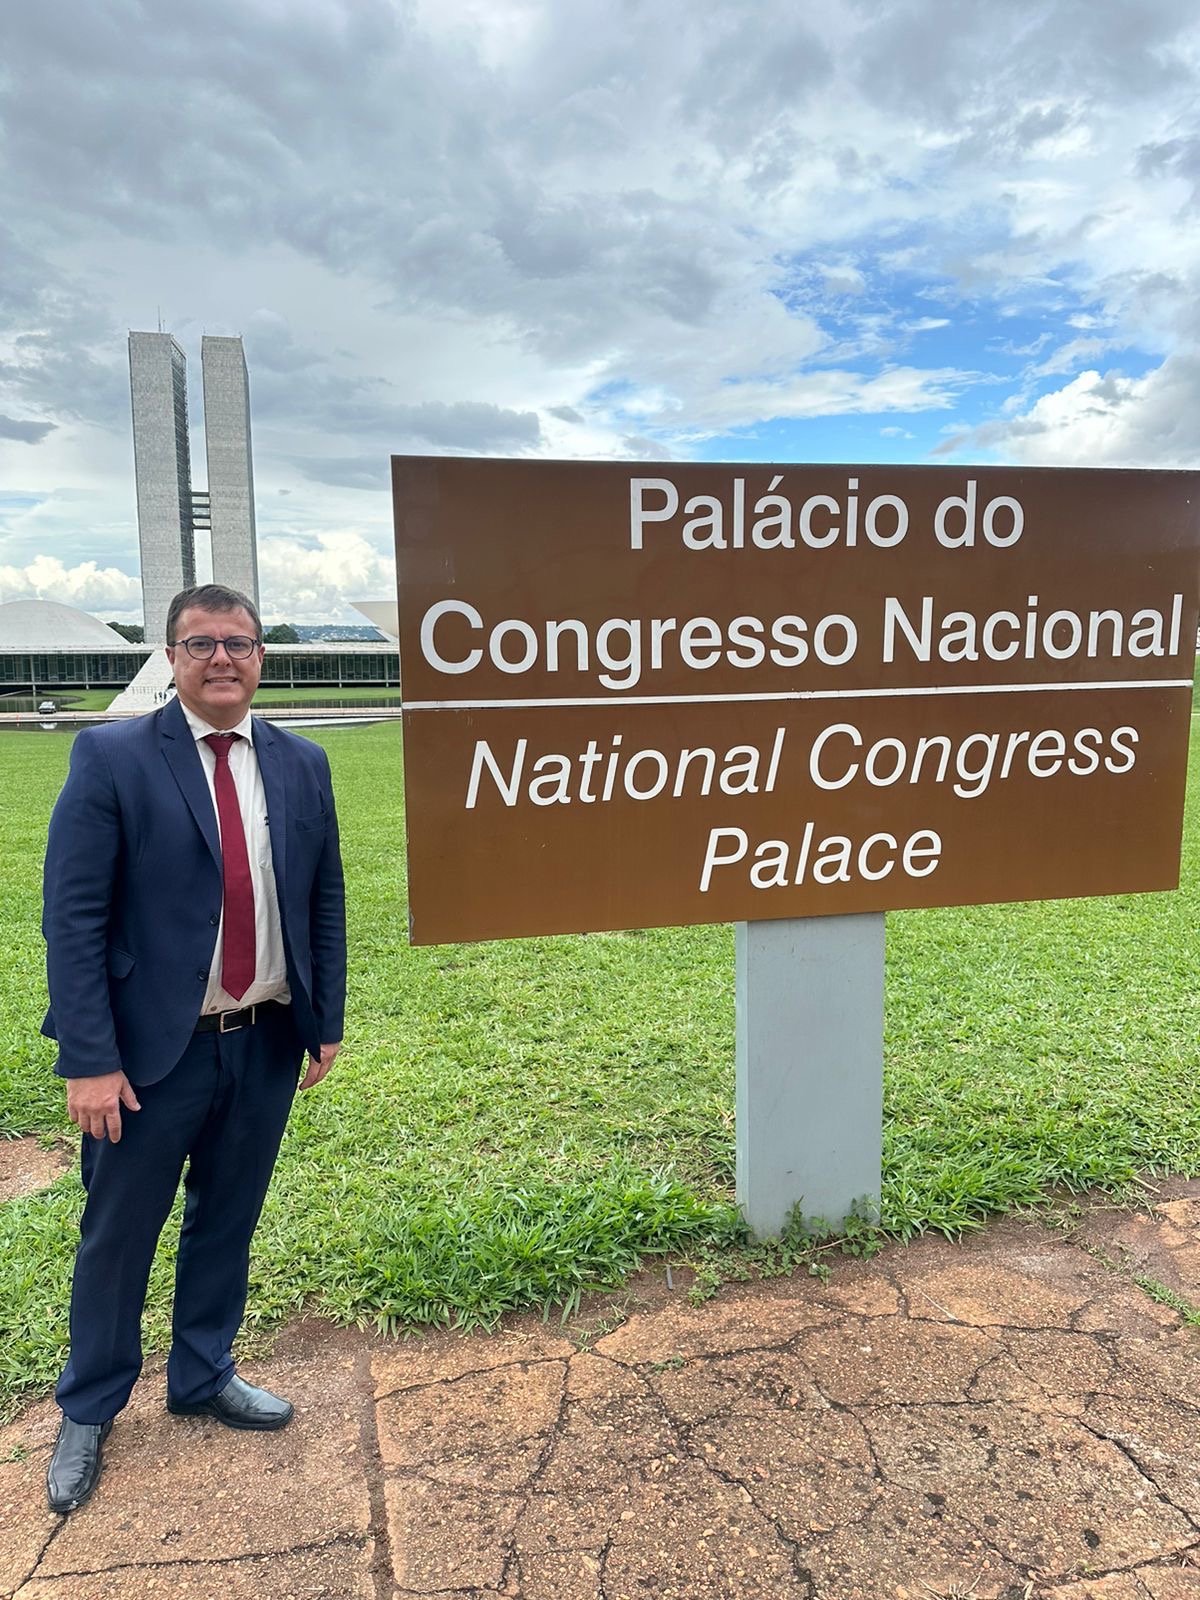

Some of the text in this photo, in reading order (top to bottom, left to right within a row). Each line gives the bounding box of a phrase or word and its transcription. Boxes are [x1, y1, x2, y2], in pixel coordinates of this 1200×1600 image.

[630, 474, 1024, 551] Palácio do
[420, 594, 1184, 690] Congresso Nacional
[465, 723, 1139, 809] National Congress
[699, 822, 942, 892] Palace
